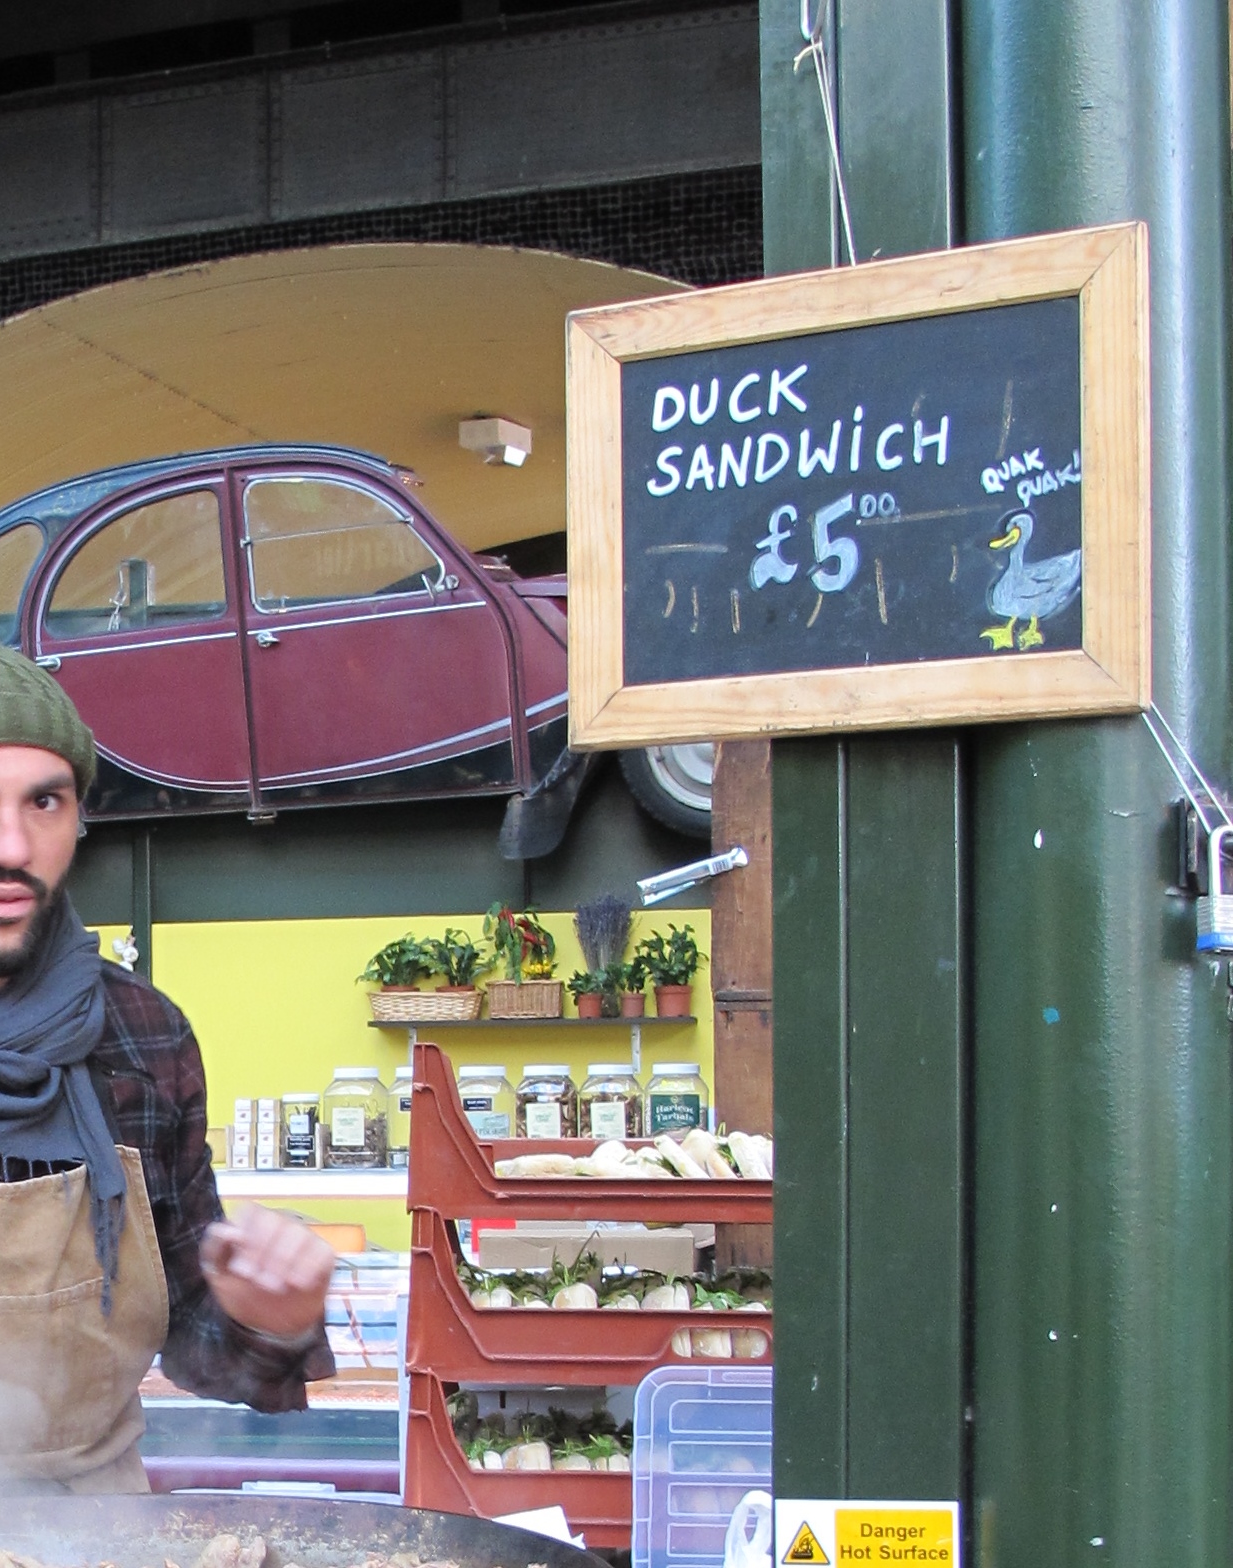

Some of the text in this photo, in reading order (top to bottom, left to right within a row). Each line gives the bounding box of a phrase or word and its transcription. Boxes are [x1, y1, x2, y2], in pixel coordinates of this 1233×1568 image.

[651, 364, 809, 433] DUCK
[980, 447, 1045, 495] QUAK
[859, 1522, 926, 1542] Danger
[840, 1544, 949, 1561] Hot Surface
